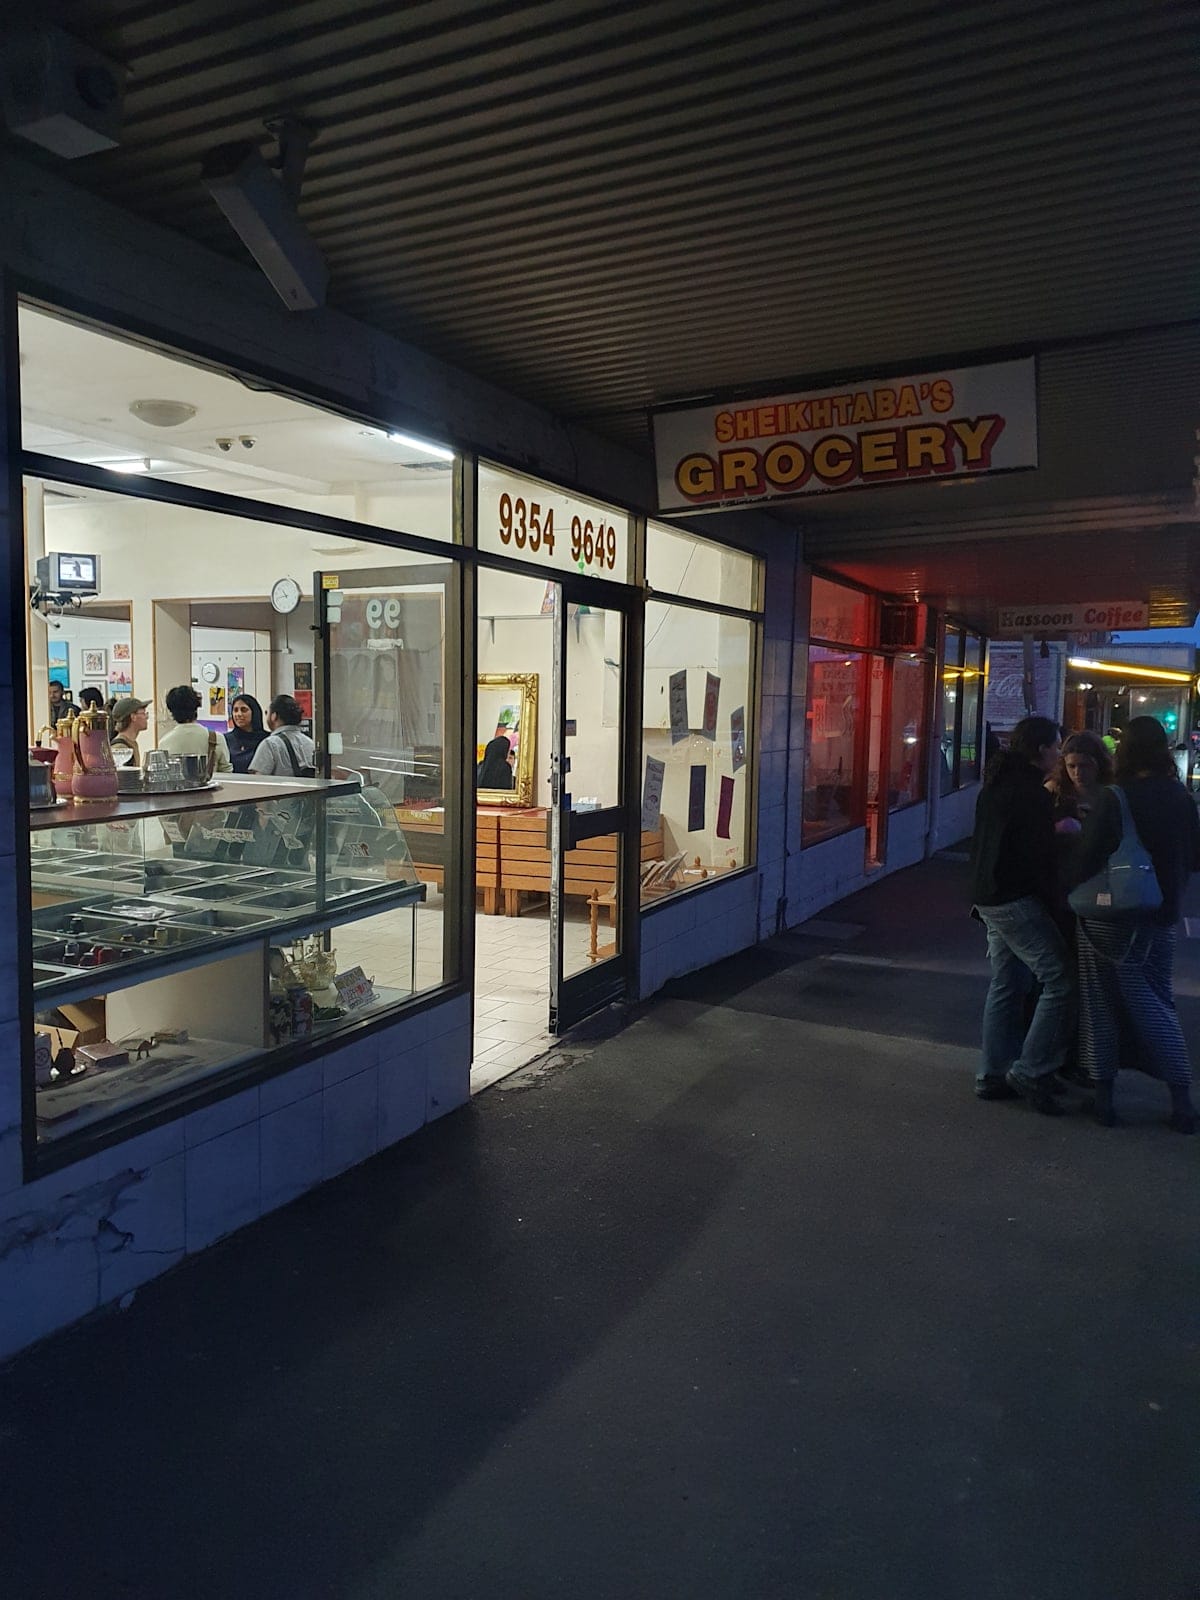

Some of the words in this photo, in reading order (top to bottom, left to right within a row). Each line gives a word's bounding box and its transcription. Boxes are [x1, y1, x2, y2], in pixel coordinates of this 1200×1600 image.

[715, 379, 954, 443] SHEIKHTABA'S
[674, 414, 1005, 502] GROCERY
[499, 493, 555, 556] 9354
[571, 515, 616, 570] 9649
[1084, 607, 1143, 627] Coffee
